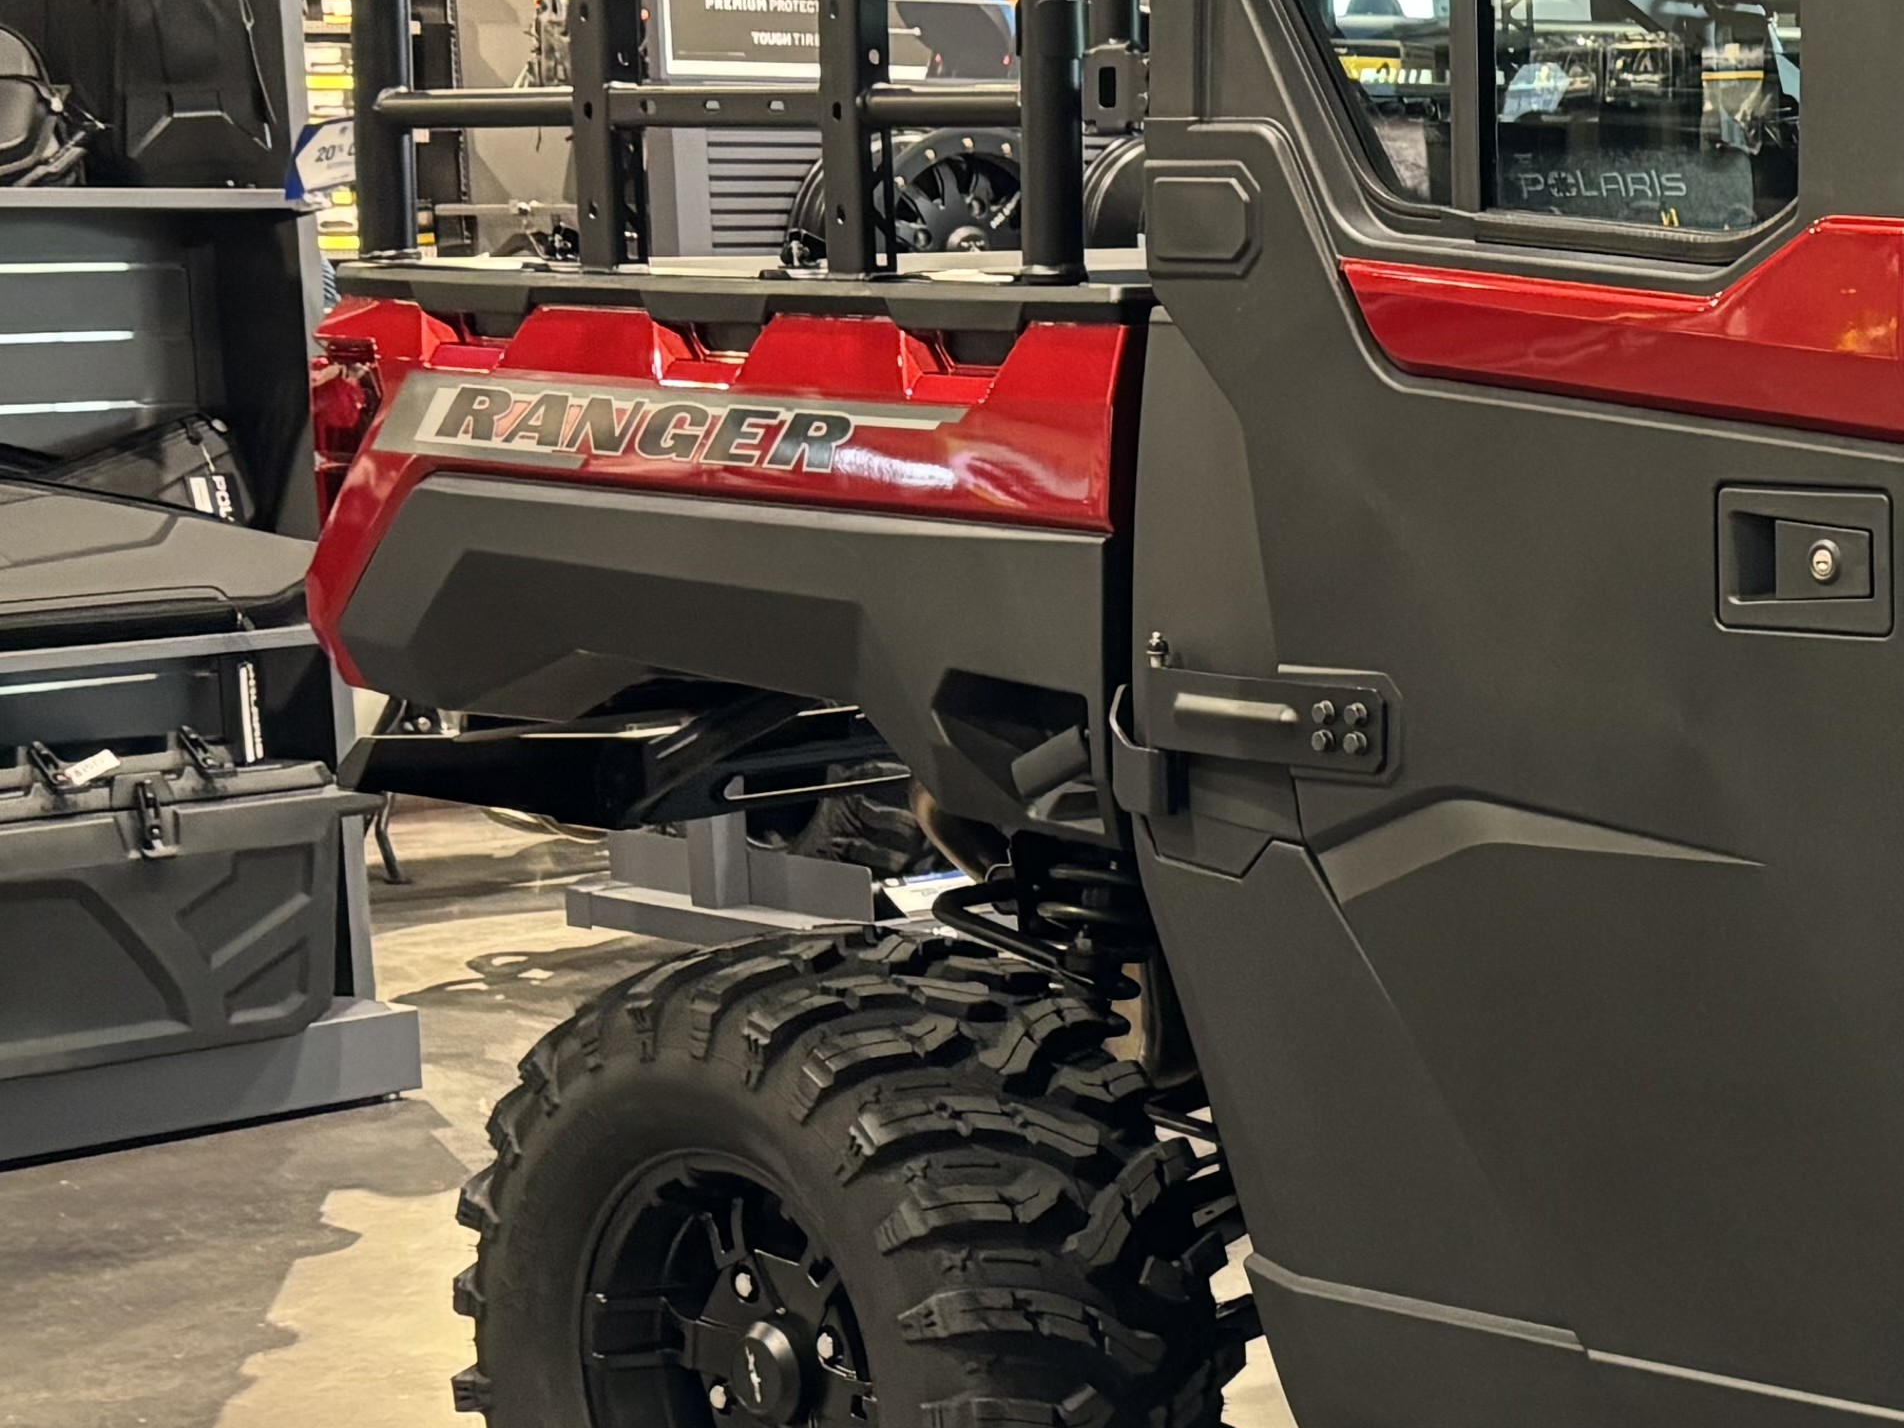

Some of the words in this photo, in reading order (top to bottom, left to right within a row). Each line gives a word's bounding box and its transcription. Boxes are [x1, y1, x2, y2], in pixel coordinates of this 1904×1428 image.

[751, 31, 791, 46] TOUGH
[1519, 169, 1688, 200] POLARIS
[433, 383, 856, 473] RANGER
